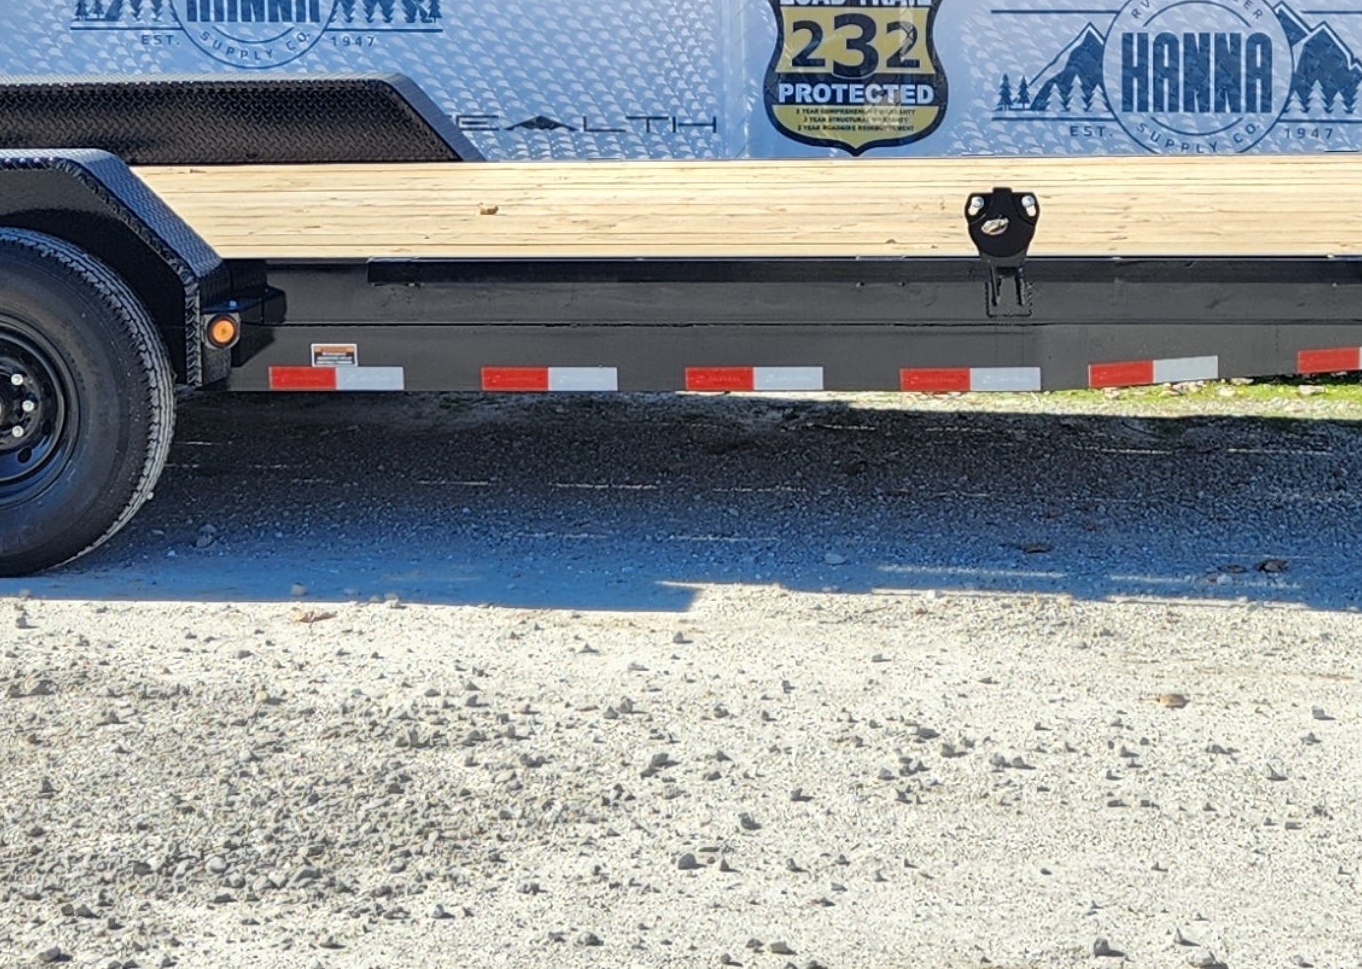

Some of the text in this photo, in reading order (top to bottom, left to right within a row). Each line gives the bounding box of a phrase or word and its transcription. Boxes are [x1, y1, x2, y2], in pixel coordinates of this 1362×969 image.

[140, 34, 181, 46] EST.
[199, 31, 274, 61] SUPPLY
[330, 35, 376, 47] 1947
[791, 12, 921, 79] 232
[1121, 32, 1273, 113] HANNA
[778, 83, 934, 105] PROTECTED
[450, 115, 717, 134] EALTH
[1069, 125, 1114, 138] EST.
[1283, 126, 1334, 139] 1947
[1136, 122, 1219, 154] SUPPLY
